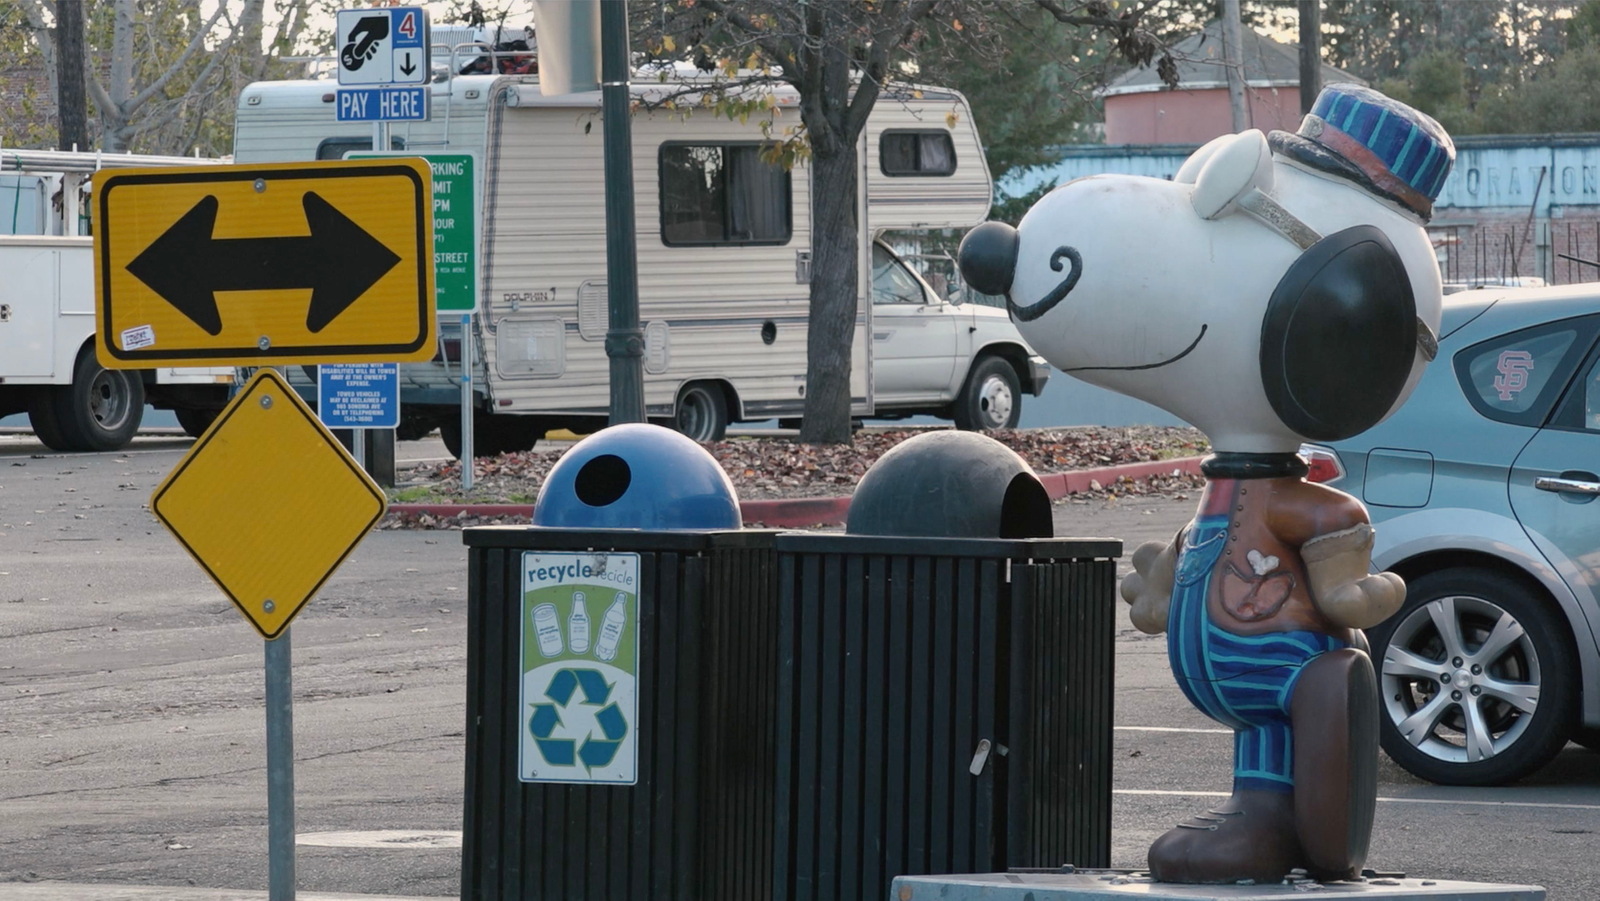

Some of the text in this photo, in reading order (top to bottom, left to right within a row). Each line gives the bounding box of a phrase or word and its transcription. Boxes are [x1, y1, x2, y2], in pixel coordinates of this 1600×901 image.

[398, 11, 417, 39] 4
[341, 91, 420, 119] PAY HERE
[432, 162, 464, 175] RKING
[433, 180, 453, 194] MIT
[1446, 165, 1597, 195] PORATION
[434, 252, 469, 263] STREET
[503, 292, 548, 303] DOLPHIN
[528, 559, 593, 583] recycle
